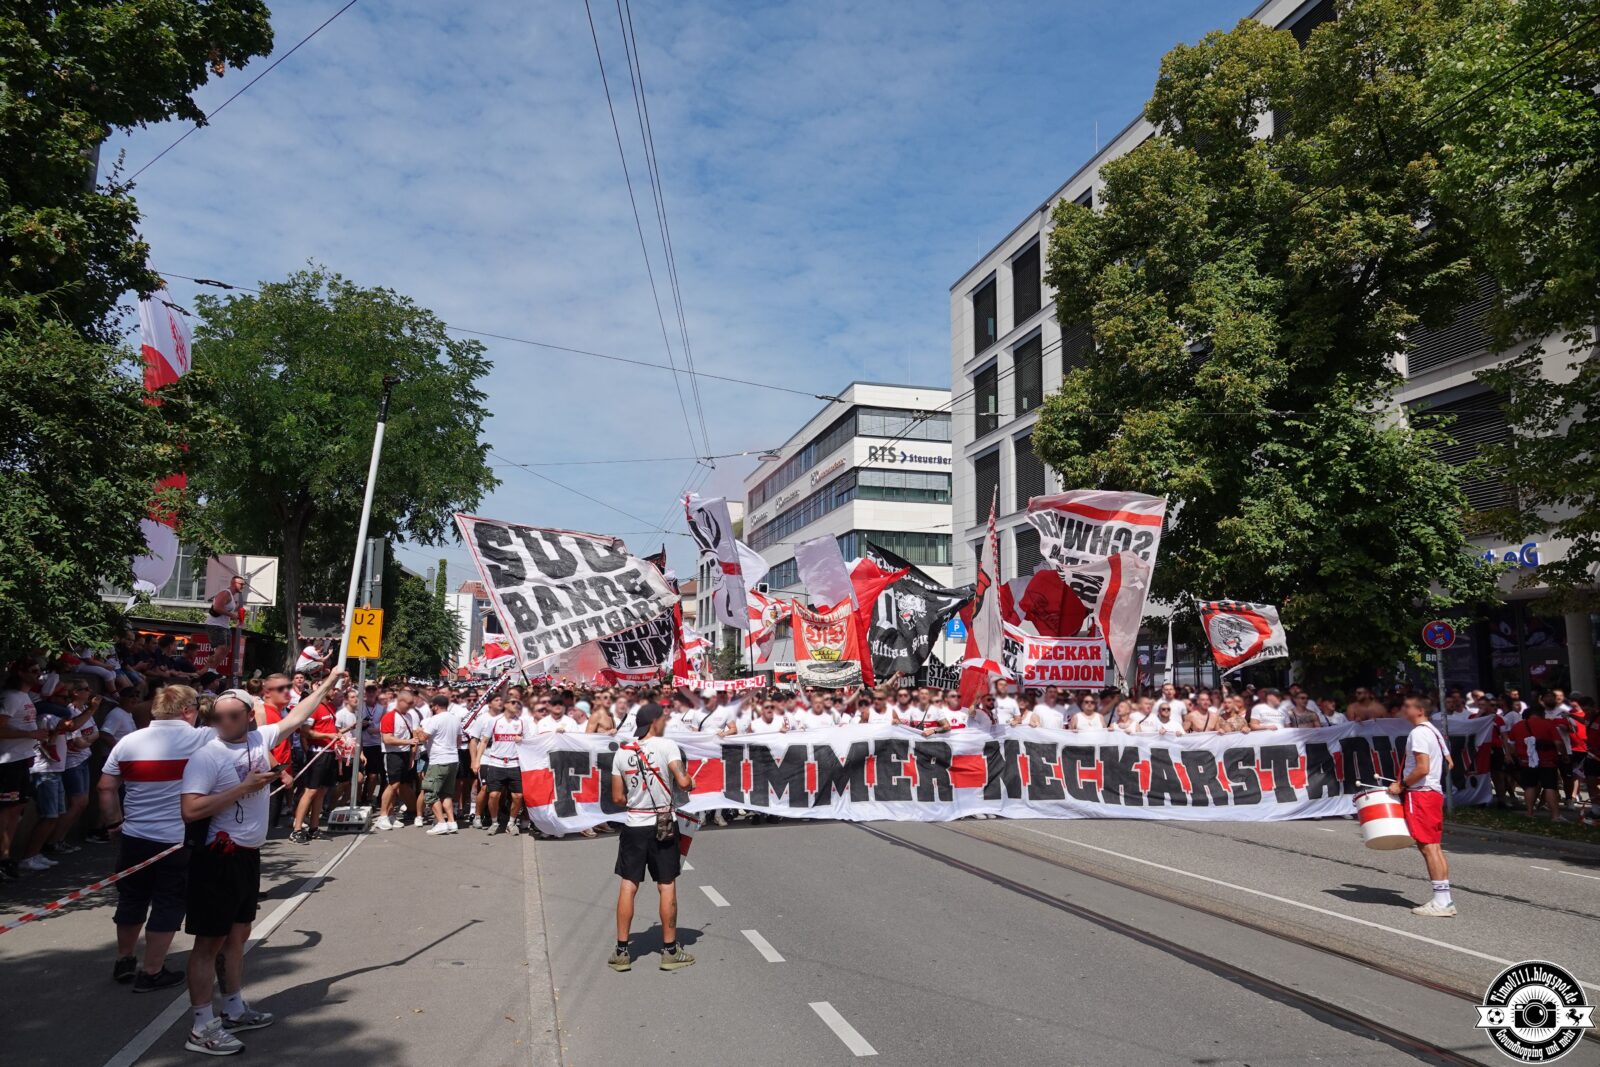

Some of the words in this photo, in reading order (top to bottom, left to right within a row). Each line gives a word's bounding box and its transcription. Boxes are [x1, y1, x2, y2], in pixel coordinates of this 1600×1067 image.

[868, 445, 897, 463] RTS
[500, 567, 651, 635] BANDE
[522, 596, 666, 661] STUTTGART
[1028, 643, 1102, 661] NECKAR
[1024, 664, 1105, 682] STADION
[721, 737, 952, 808] IMMER
